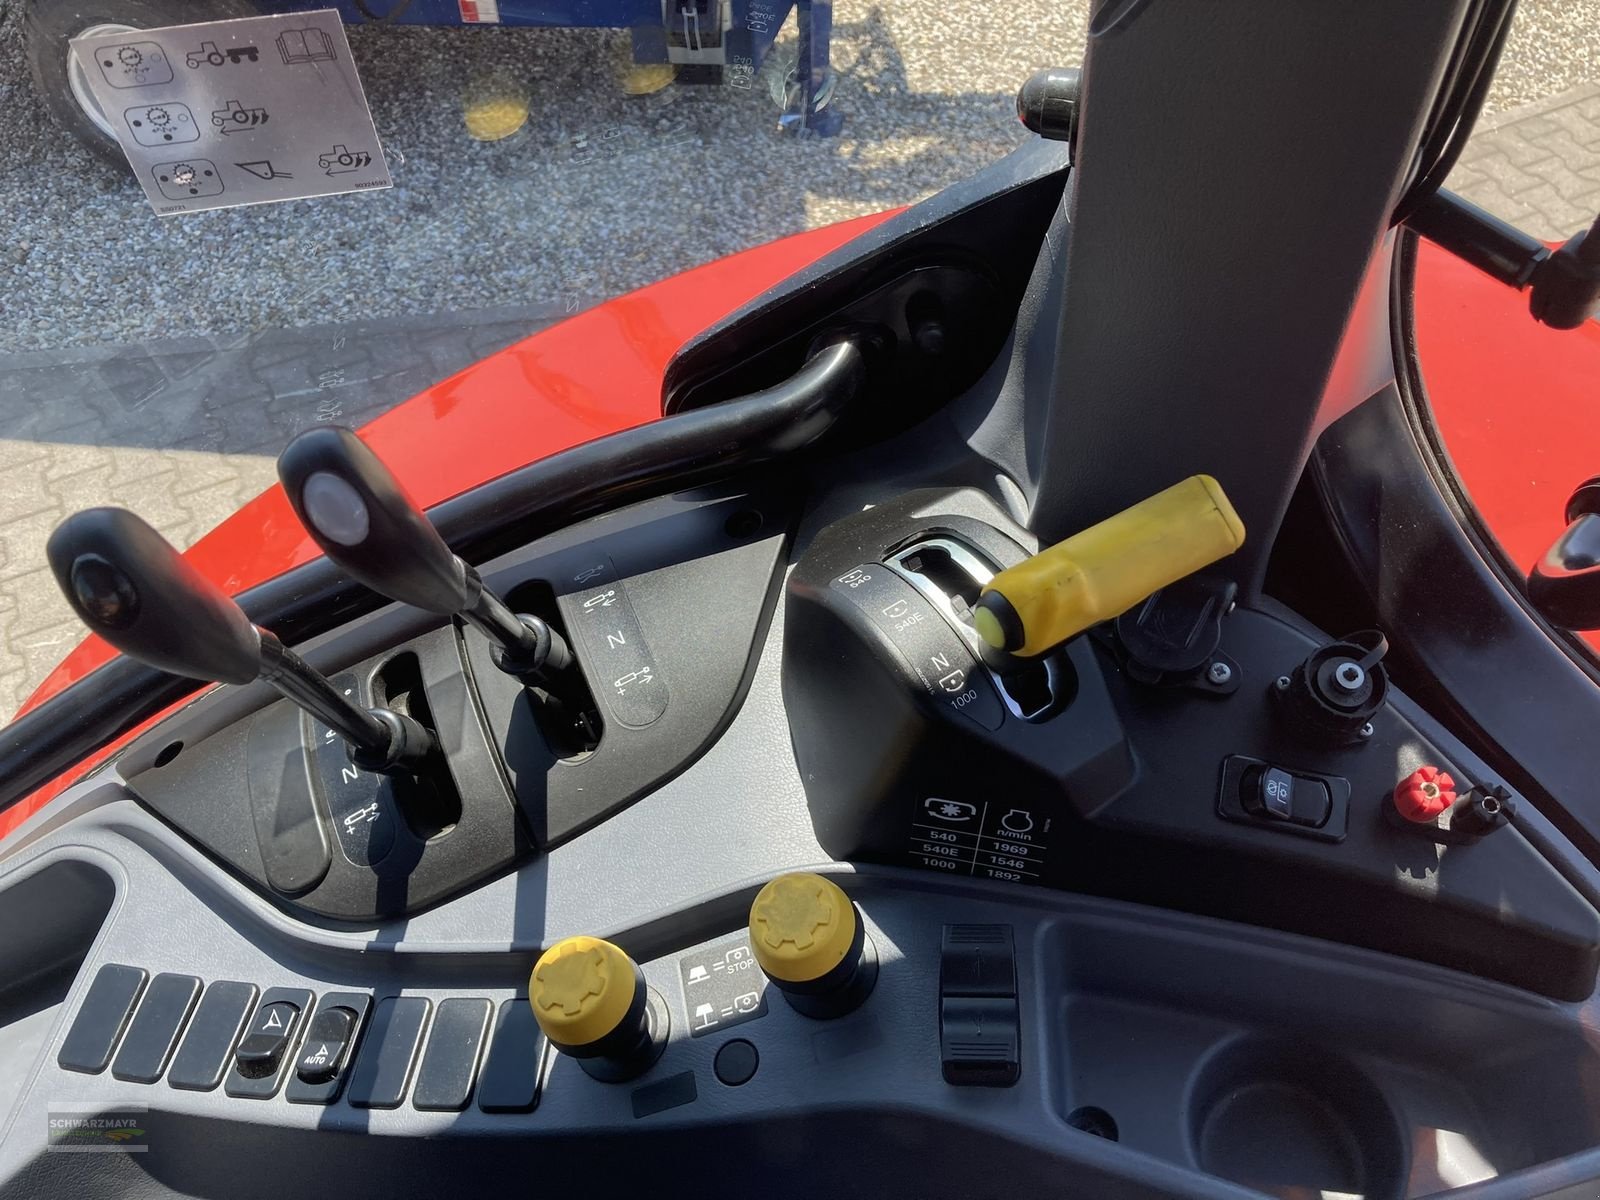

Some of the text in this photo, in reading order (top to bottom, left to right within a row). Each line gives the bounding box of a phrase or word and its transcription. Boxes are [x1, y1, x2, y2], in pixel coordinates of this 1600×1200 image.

[894, 611, 924, 632] 540E
[607, 630, 626, 650] N
[931, 652, 950, 671] N
[951, 689, 977, 709] 1000
[341, 763, 359, 785] N
[930, 831, 957, 842] 540
[997, 829, 1032, 841] n/min
[923, 843, 959, 857] 540E
[993, 842, 1028, 855] 1969
[922, 857, 956, 870] 1000
[990, 855, 1025, 869] 1546
[987, 869, 1021, 882] 1892
[727, 958, 754, 974] STOP
[304, 1055, 326, 1065] AUTO
